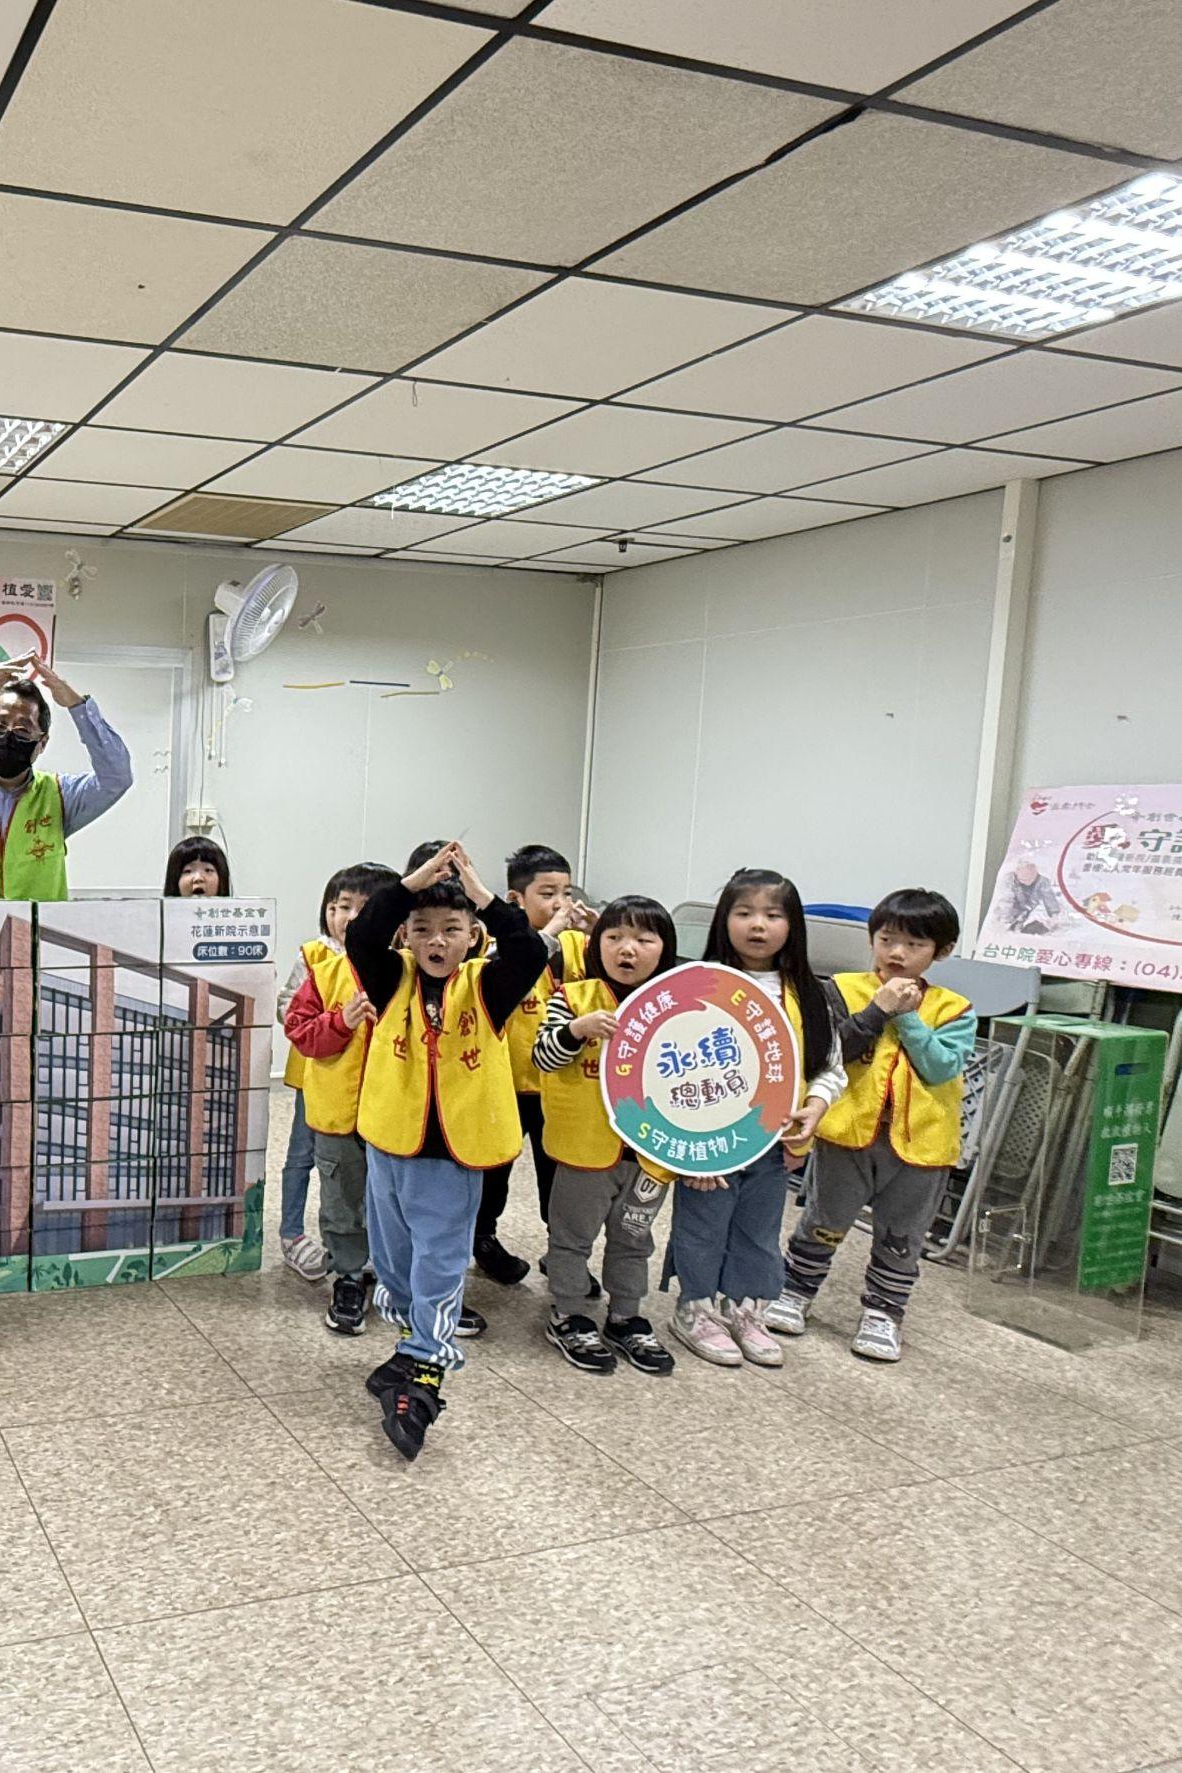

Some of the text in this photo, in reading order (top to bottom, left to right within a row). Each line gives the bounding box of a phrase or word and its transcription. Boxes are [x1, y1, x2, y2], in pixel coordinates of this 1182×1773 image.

[207, 907, 268, 918] 創世基金會
[191, 924, 271, 938] 花蓮新院示意圖
[1133, 960, 1182, 980] (04)
[617, 989, 679, 1059] 守護健康
[656, 1025, 741, 1079] 永續
[746, 1000, 784, 1084] 守護地球
[669, 1069, 749, 1110] 總動員
[651, 1129, 749, 1162] 守護植物人
[640, 1178, 658, 1194] 07
